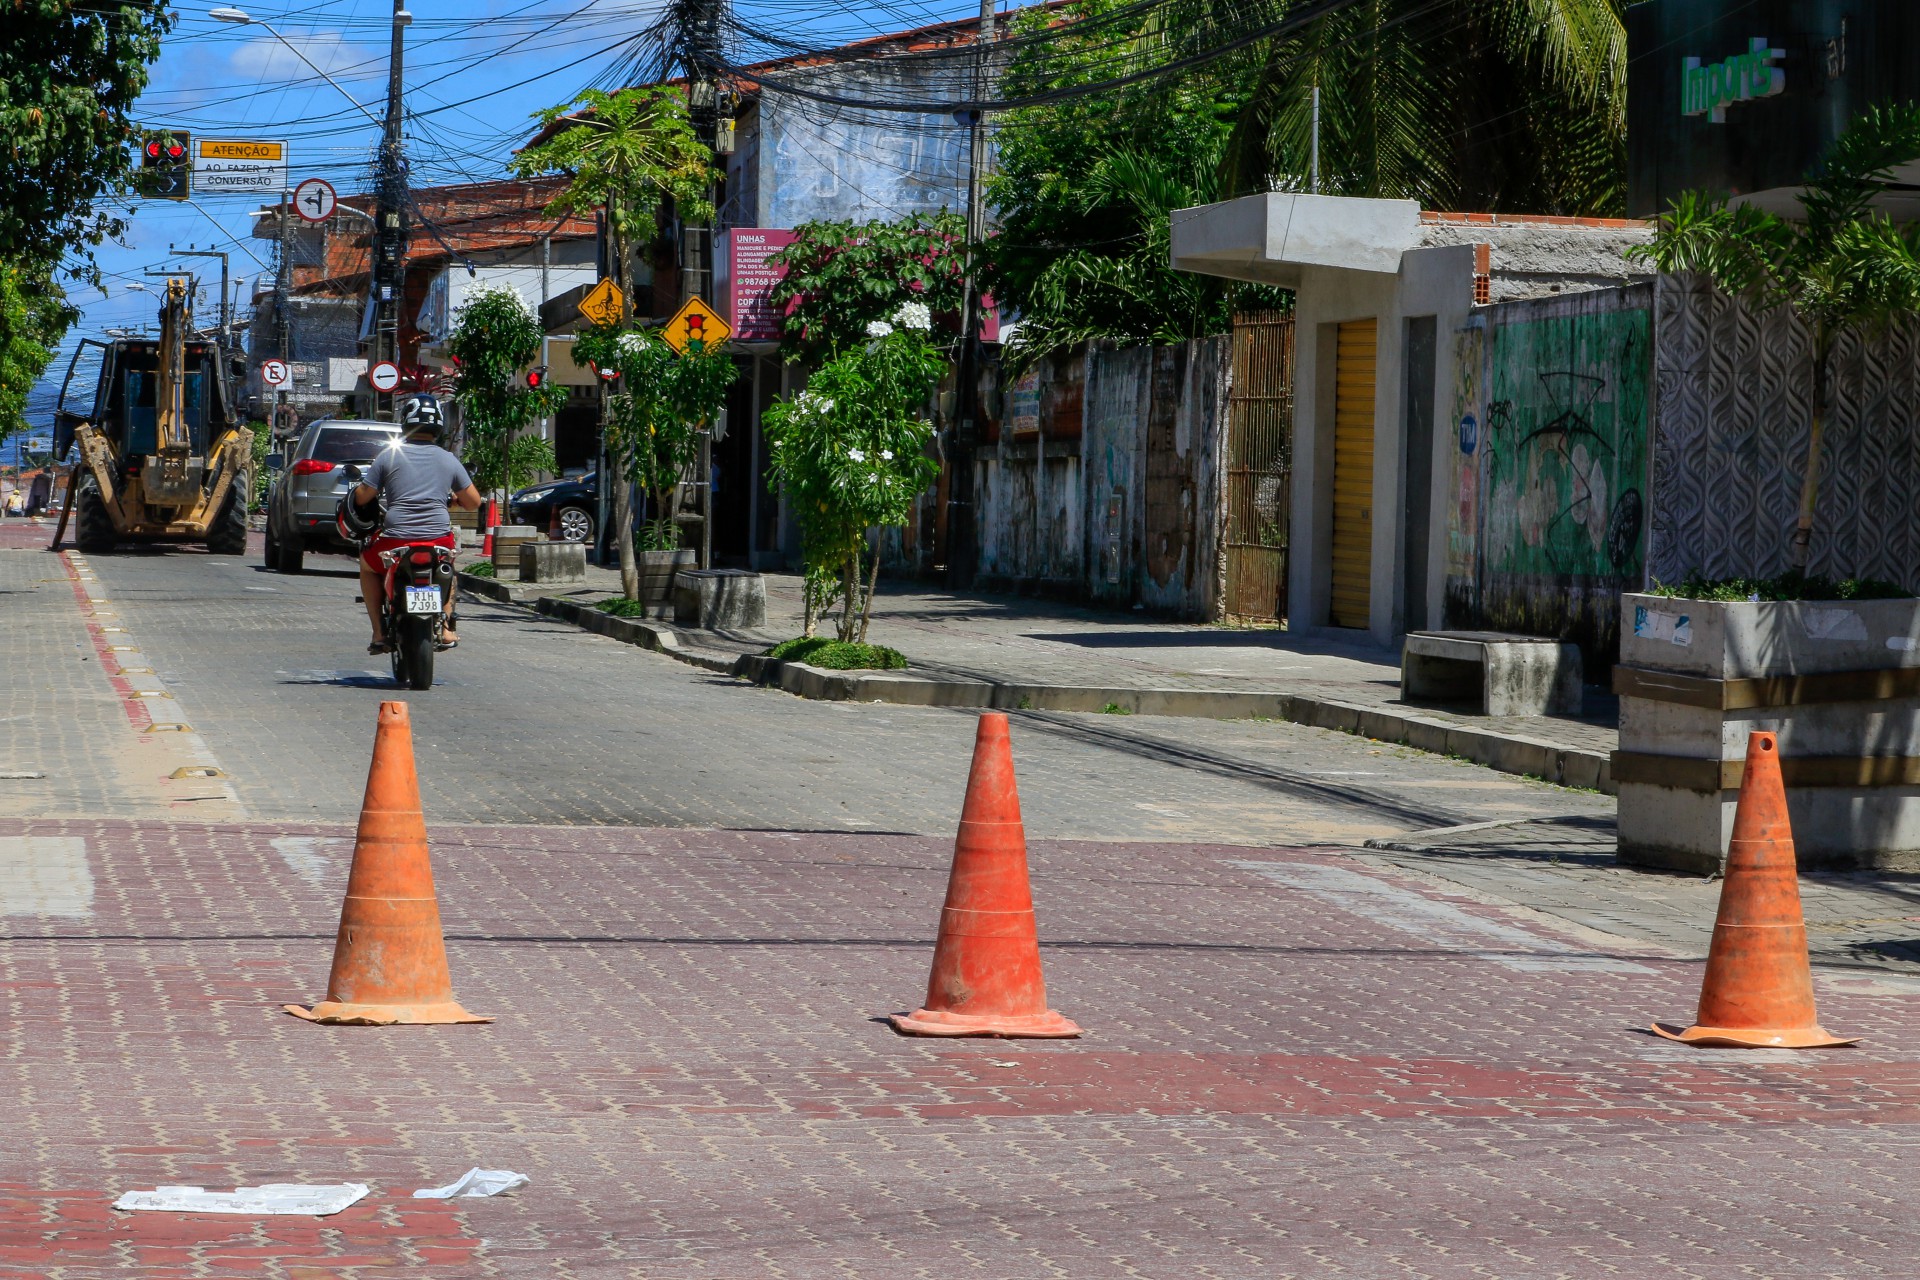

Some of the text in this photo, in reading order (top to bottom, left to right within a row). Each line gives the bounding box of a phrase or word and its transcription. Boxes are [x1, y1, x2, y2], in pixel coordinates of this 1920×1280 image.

[1681, 36, 1786, 124] Imports
[212, 145, 270, 157] ATENÇÃO
[205, 164, 275, 173] AO FAZER A
[207, 176, 272, 186] CONVERSÃO
[736, 235, 766, 243] UNHAS
[744, 278, 783, 286] 98768 52
[737, 298, 768, 306] CORTES
[414, 592, 434, 602] RIH
[411, 601, 438, 611] 7J98
